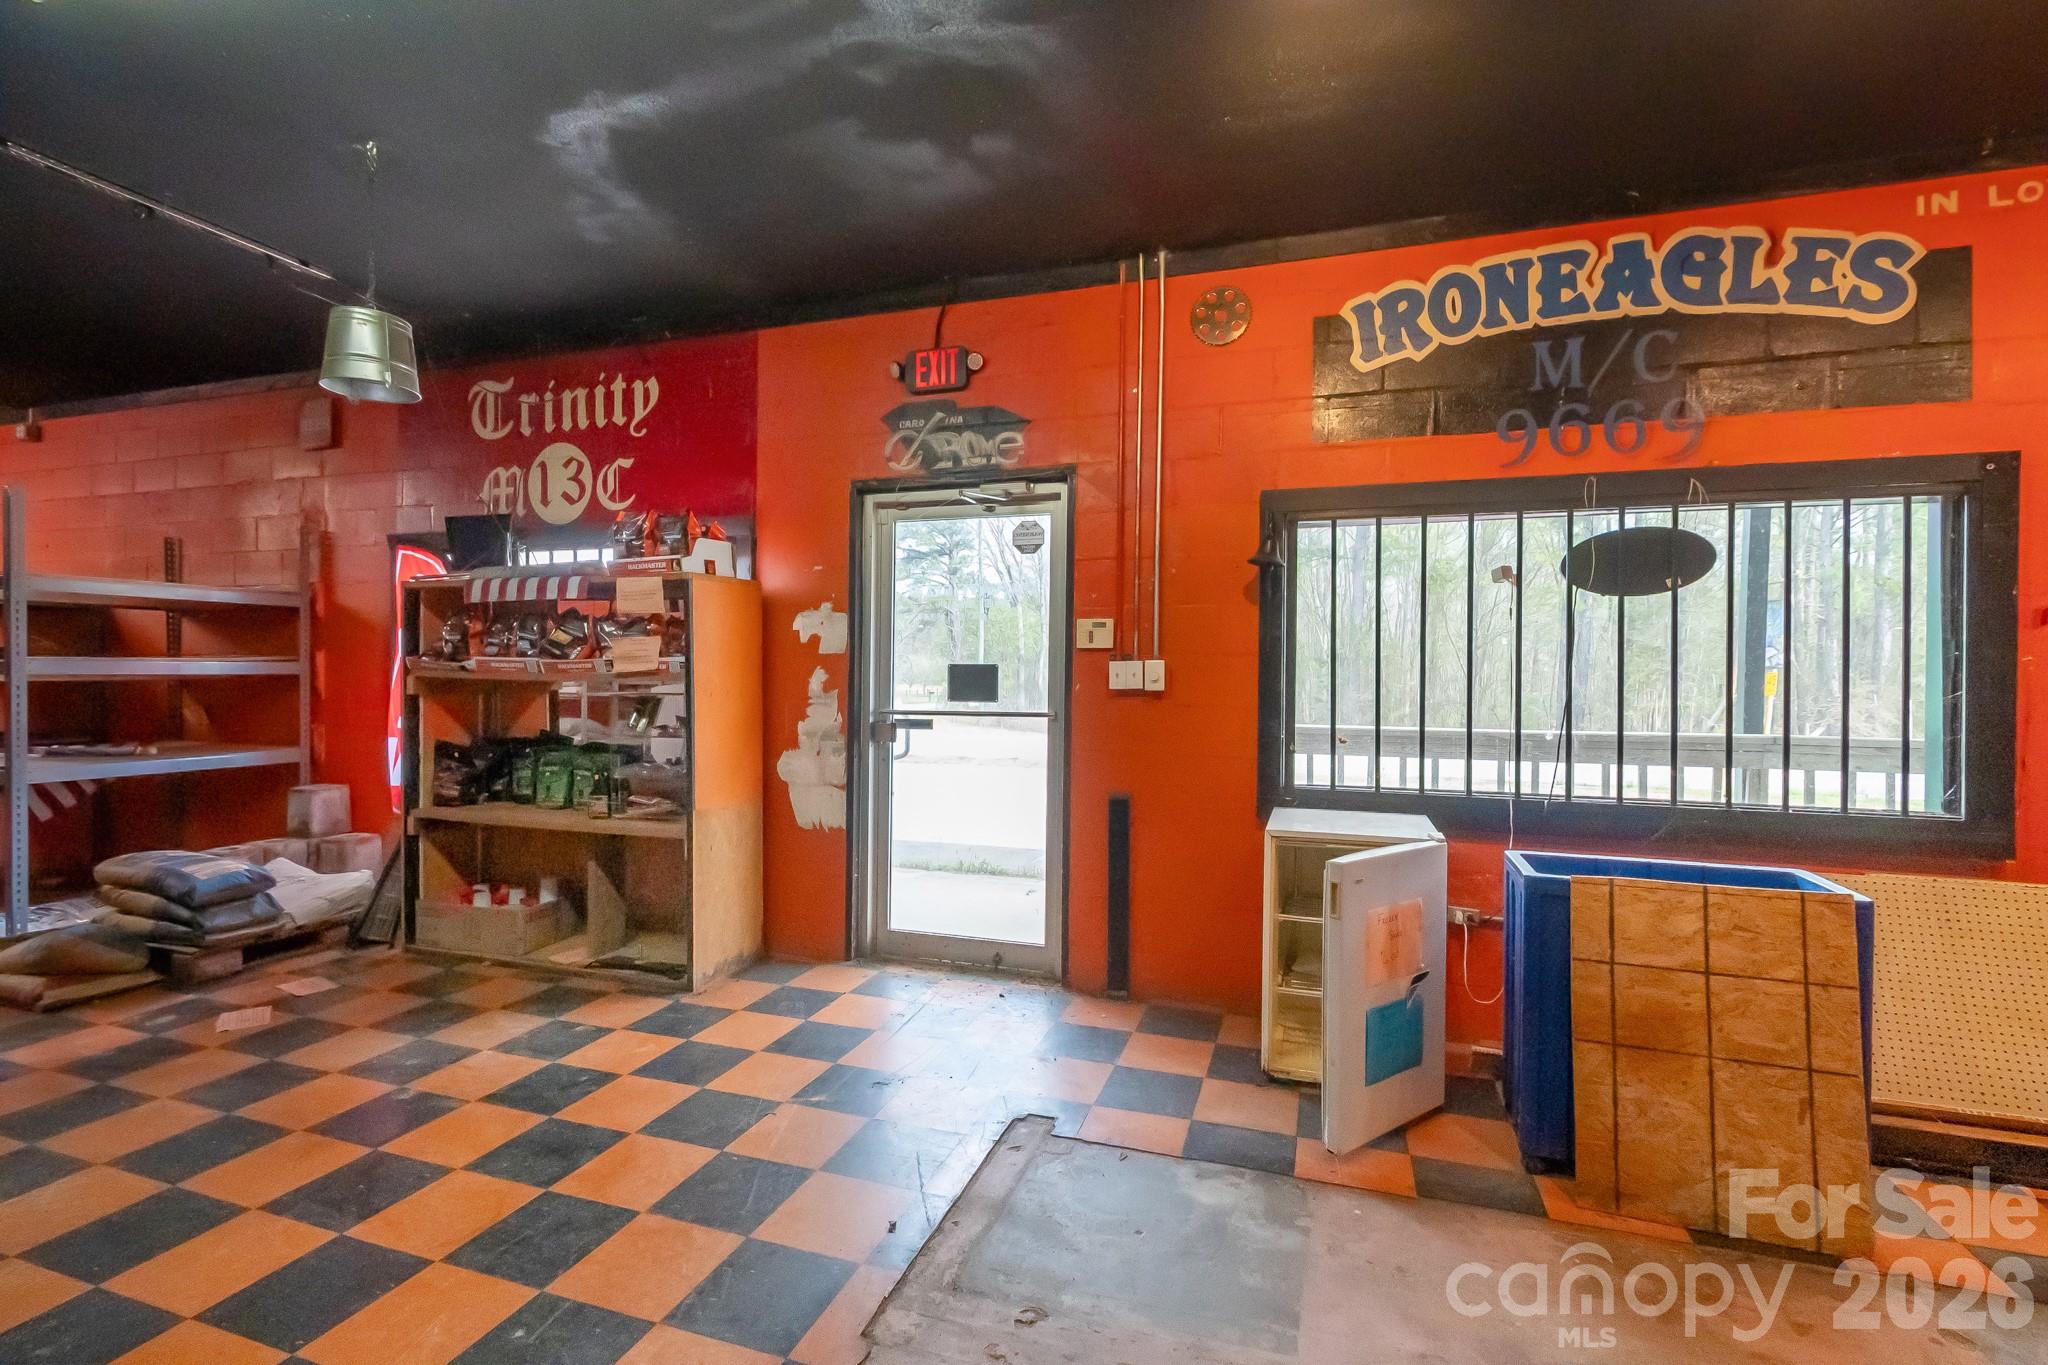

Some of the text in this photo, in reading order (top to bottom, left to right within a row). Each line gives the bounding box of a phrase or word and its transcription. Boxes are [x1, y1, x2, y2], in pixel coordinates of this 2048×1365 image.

[1915, 180, 2047, 217] IN LO
[915, 349, 958, 389] EXIT
[1529, 328, 1679, 392] M/C
[467, 372, 660, 440] Trinity
[1496, 398, 1706, 468] 9669
